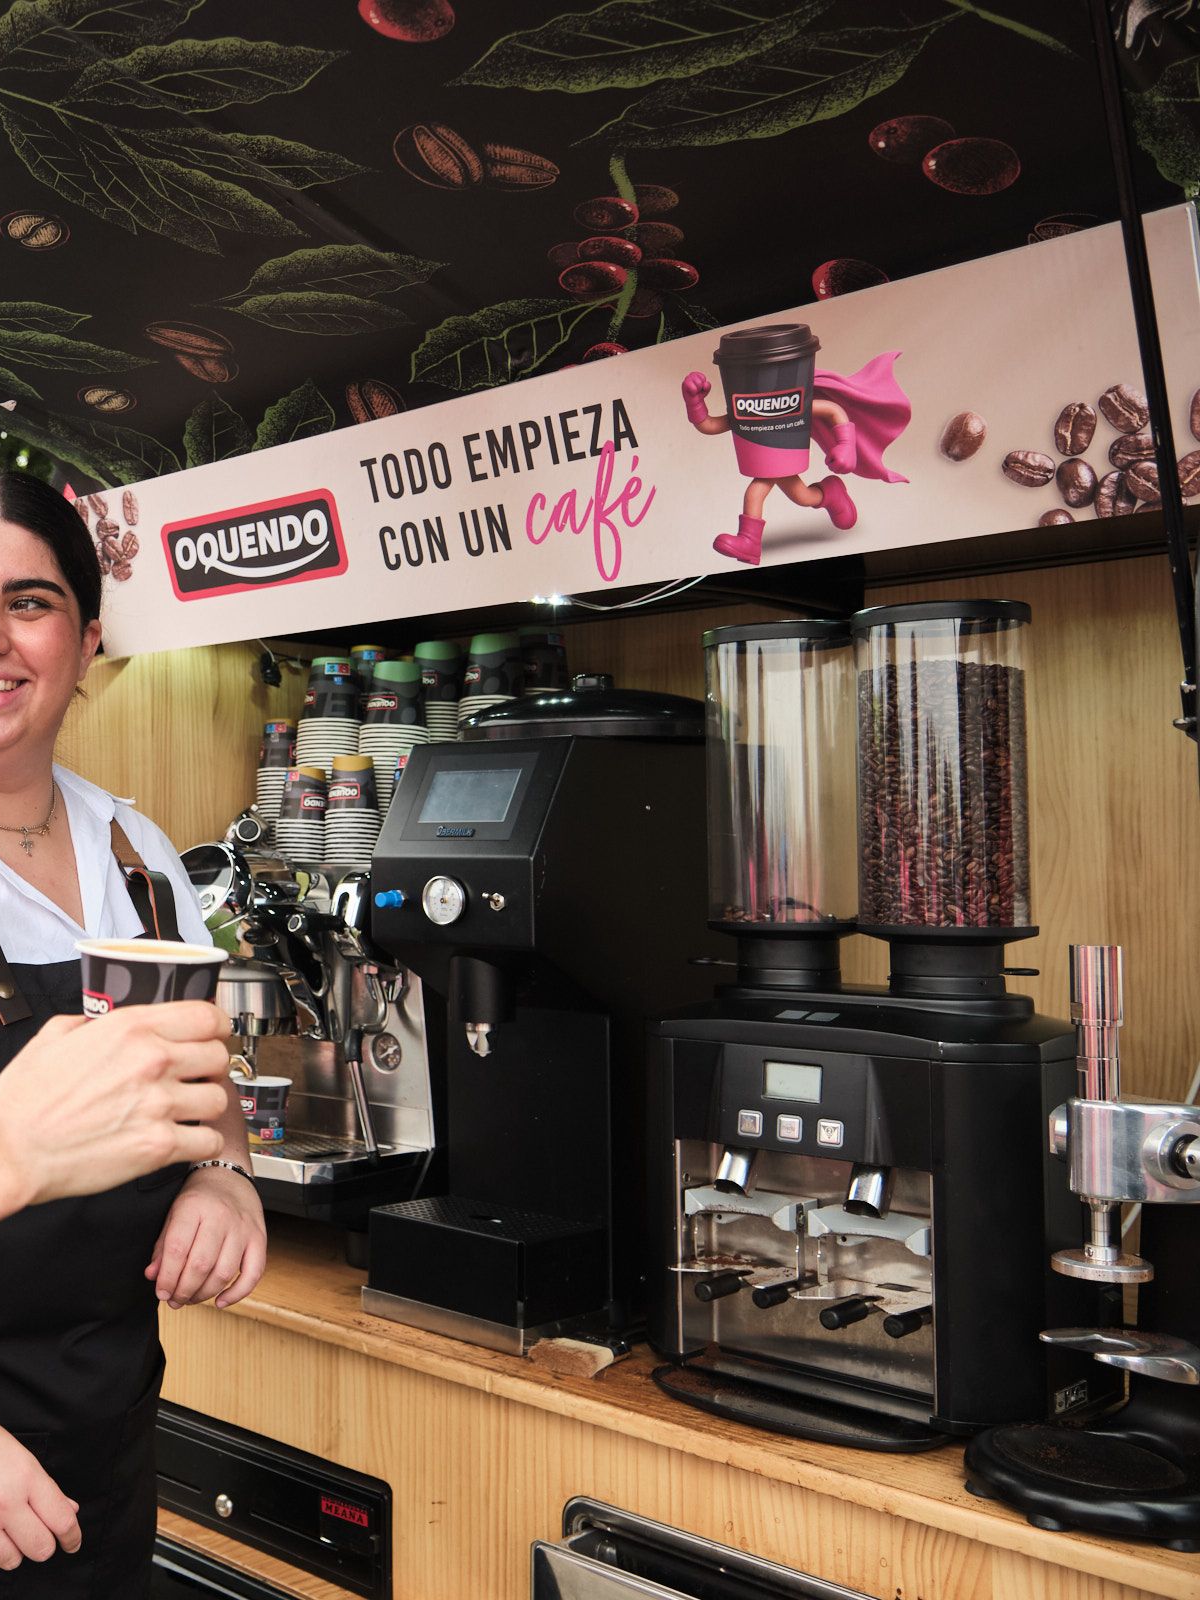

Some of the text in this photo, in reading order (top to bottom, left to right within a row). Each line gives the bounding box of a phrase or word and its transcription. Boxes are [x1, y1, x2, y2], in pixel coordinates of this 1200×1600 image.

[736, 394, 800, 417] OQUENDO
[360, 398, 639, 504] TODO EMPIEZA
[175, 509, 330, 578] OQUENDO
[378, 439, 657, 582] CON UN café
